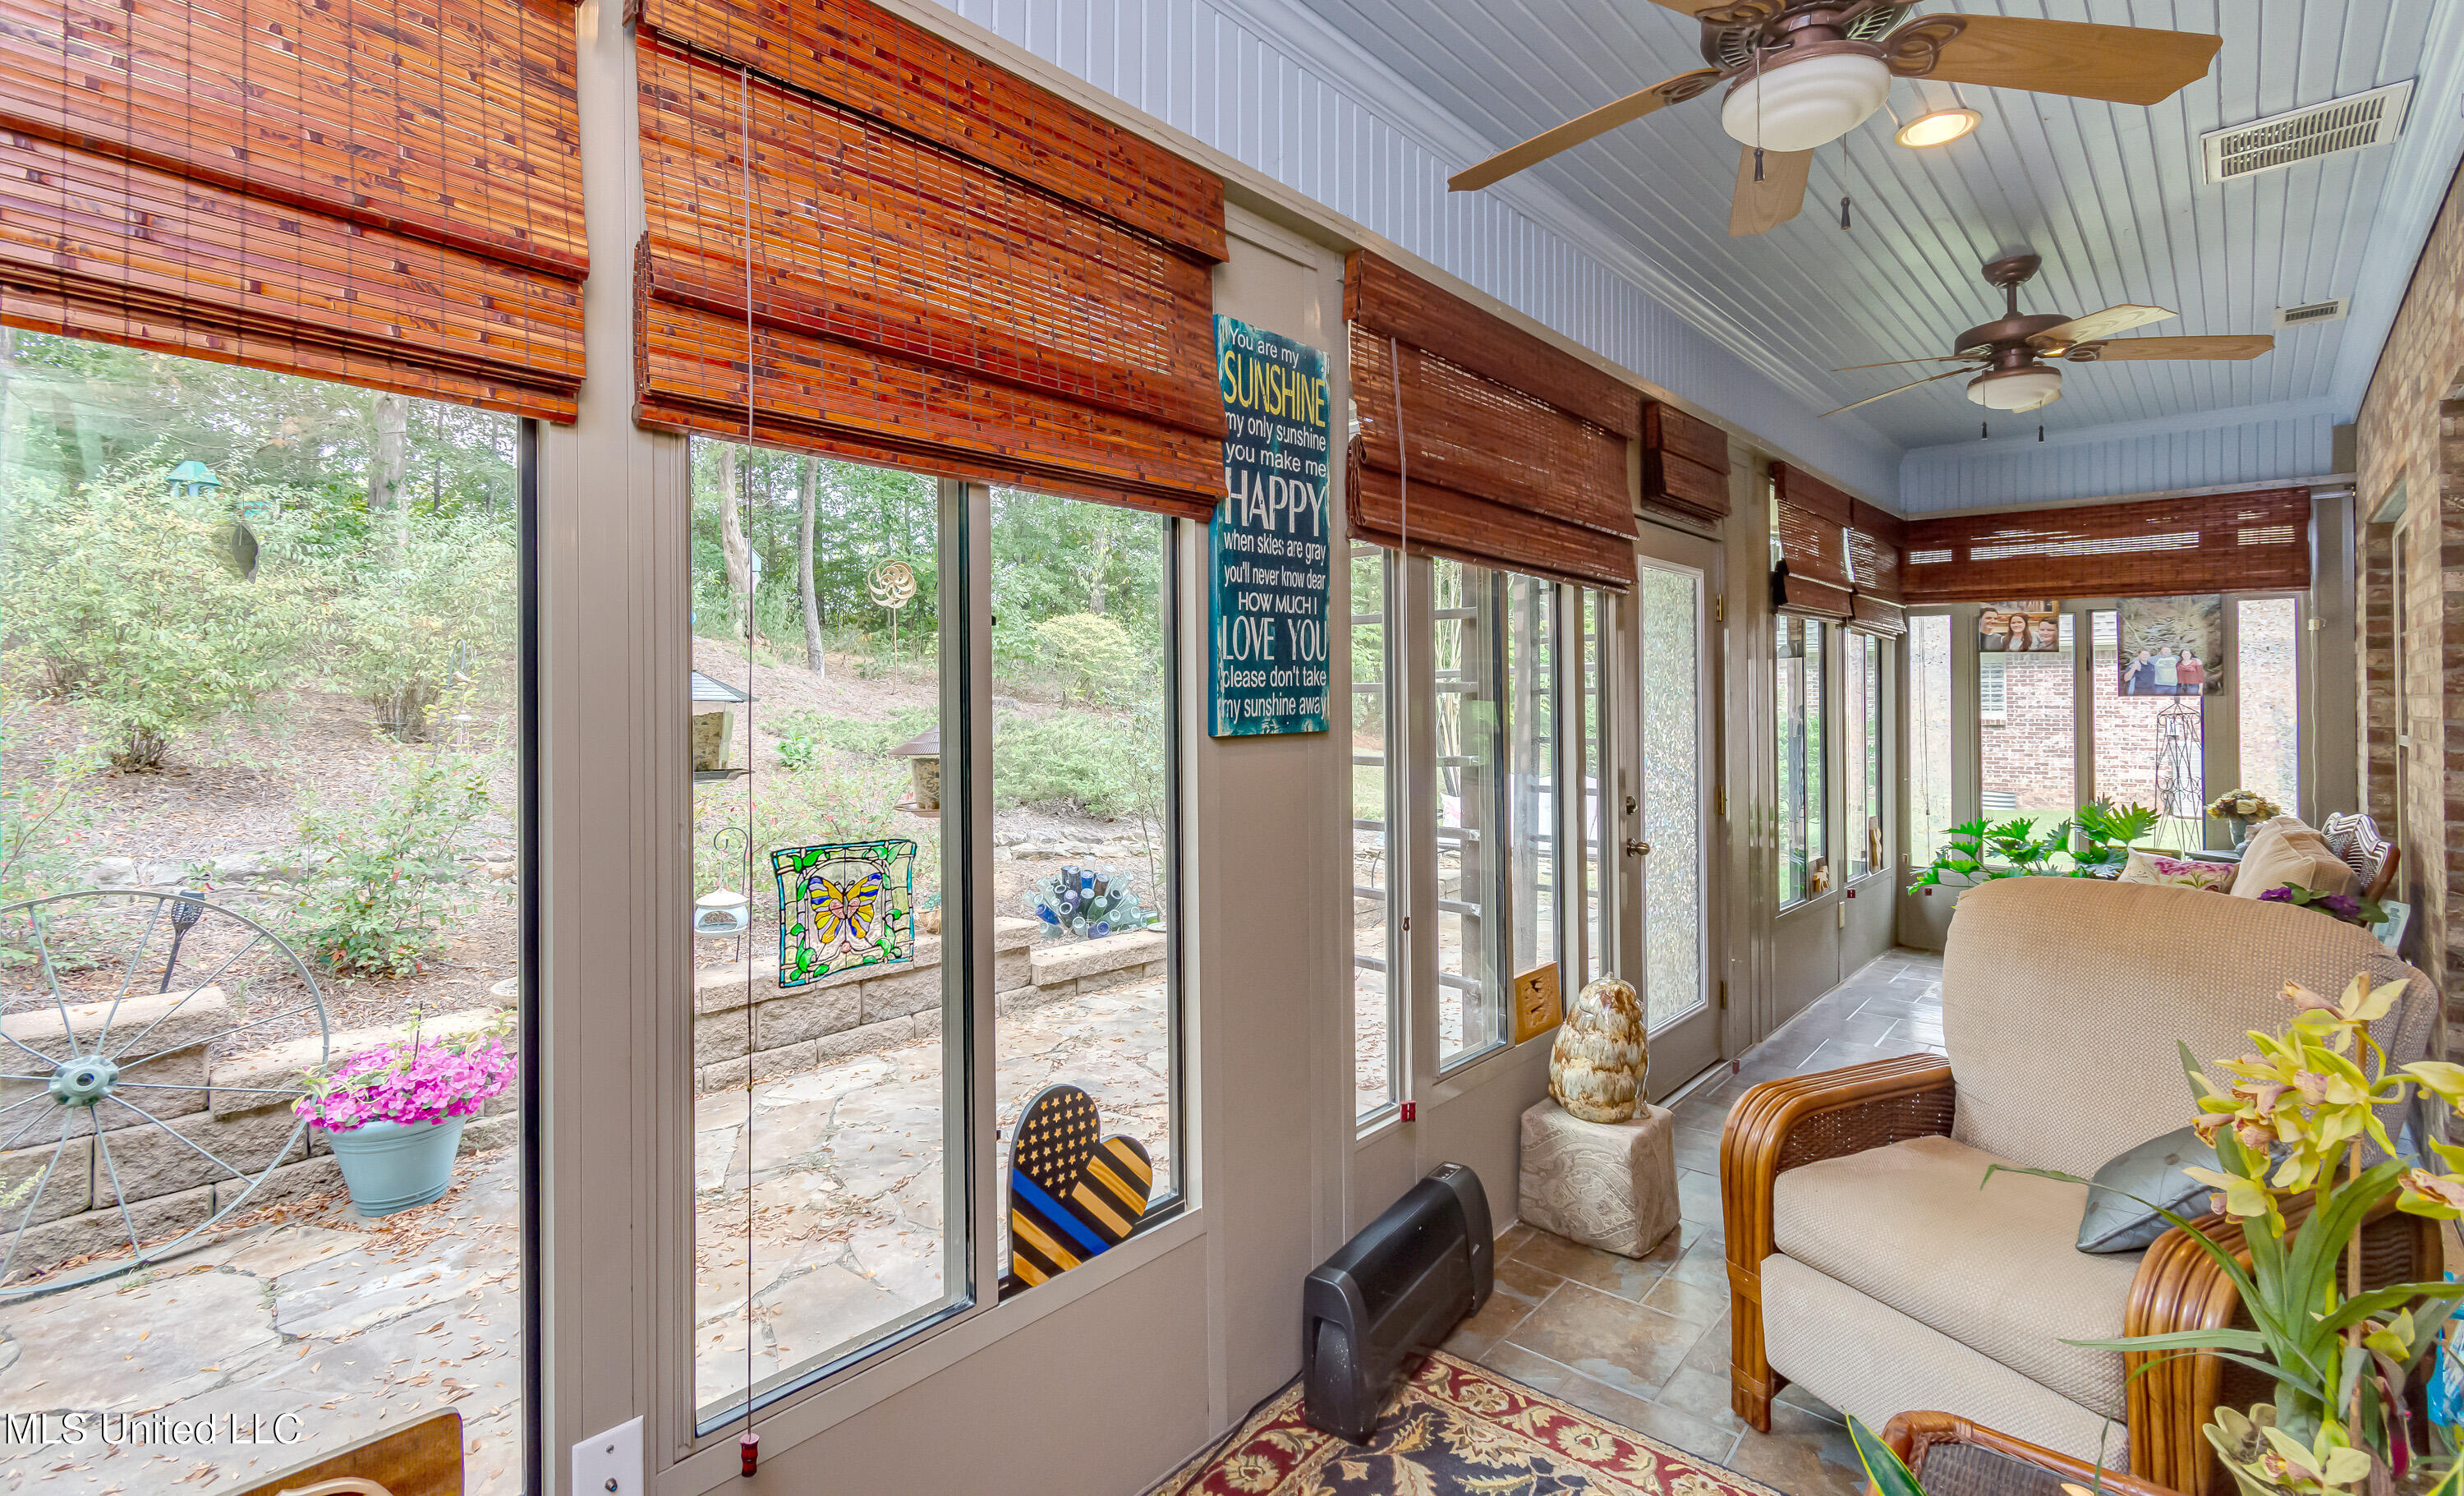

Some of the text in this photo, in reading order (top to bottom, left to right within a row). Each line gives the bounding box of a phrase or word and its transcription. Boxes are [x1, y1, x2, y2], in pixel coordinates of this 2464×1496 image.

[1229, 328, 1299, 368] You are my
[1223, 350, 1326, 428] SUNSHINE
[1225, 411, 1326, 452] my only sunshine
[1225, 441, 1326, 477] you make me
[1225, 467, 1326, 536] HAPPY
[1224, 532, 1326, 567] when skies are gray
[1224, 561, 1326, 590] you'll never know dear
[1238, 591, 1317, 615] HOW MUCH I
[1223, 615, 1327, 661] LOVE YOU
[1222, 665, 1327, 693] please don't take
[1221, 692, 1327, 725] my sunshine away
